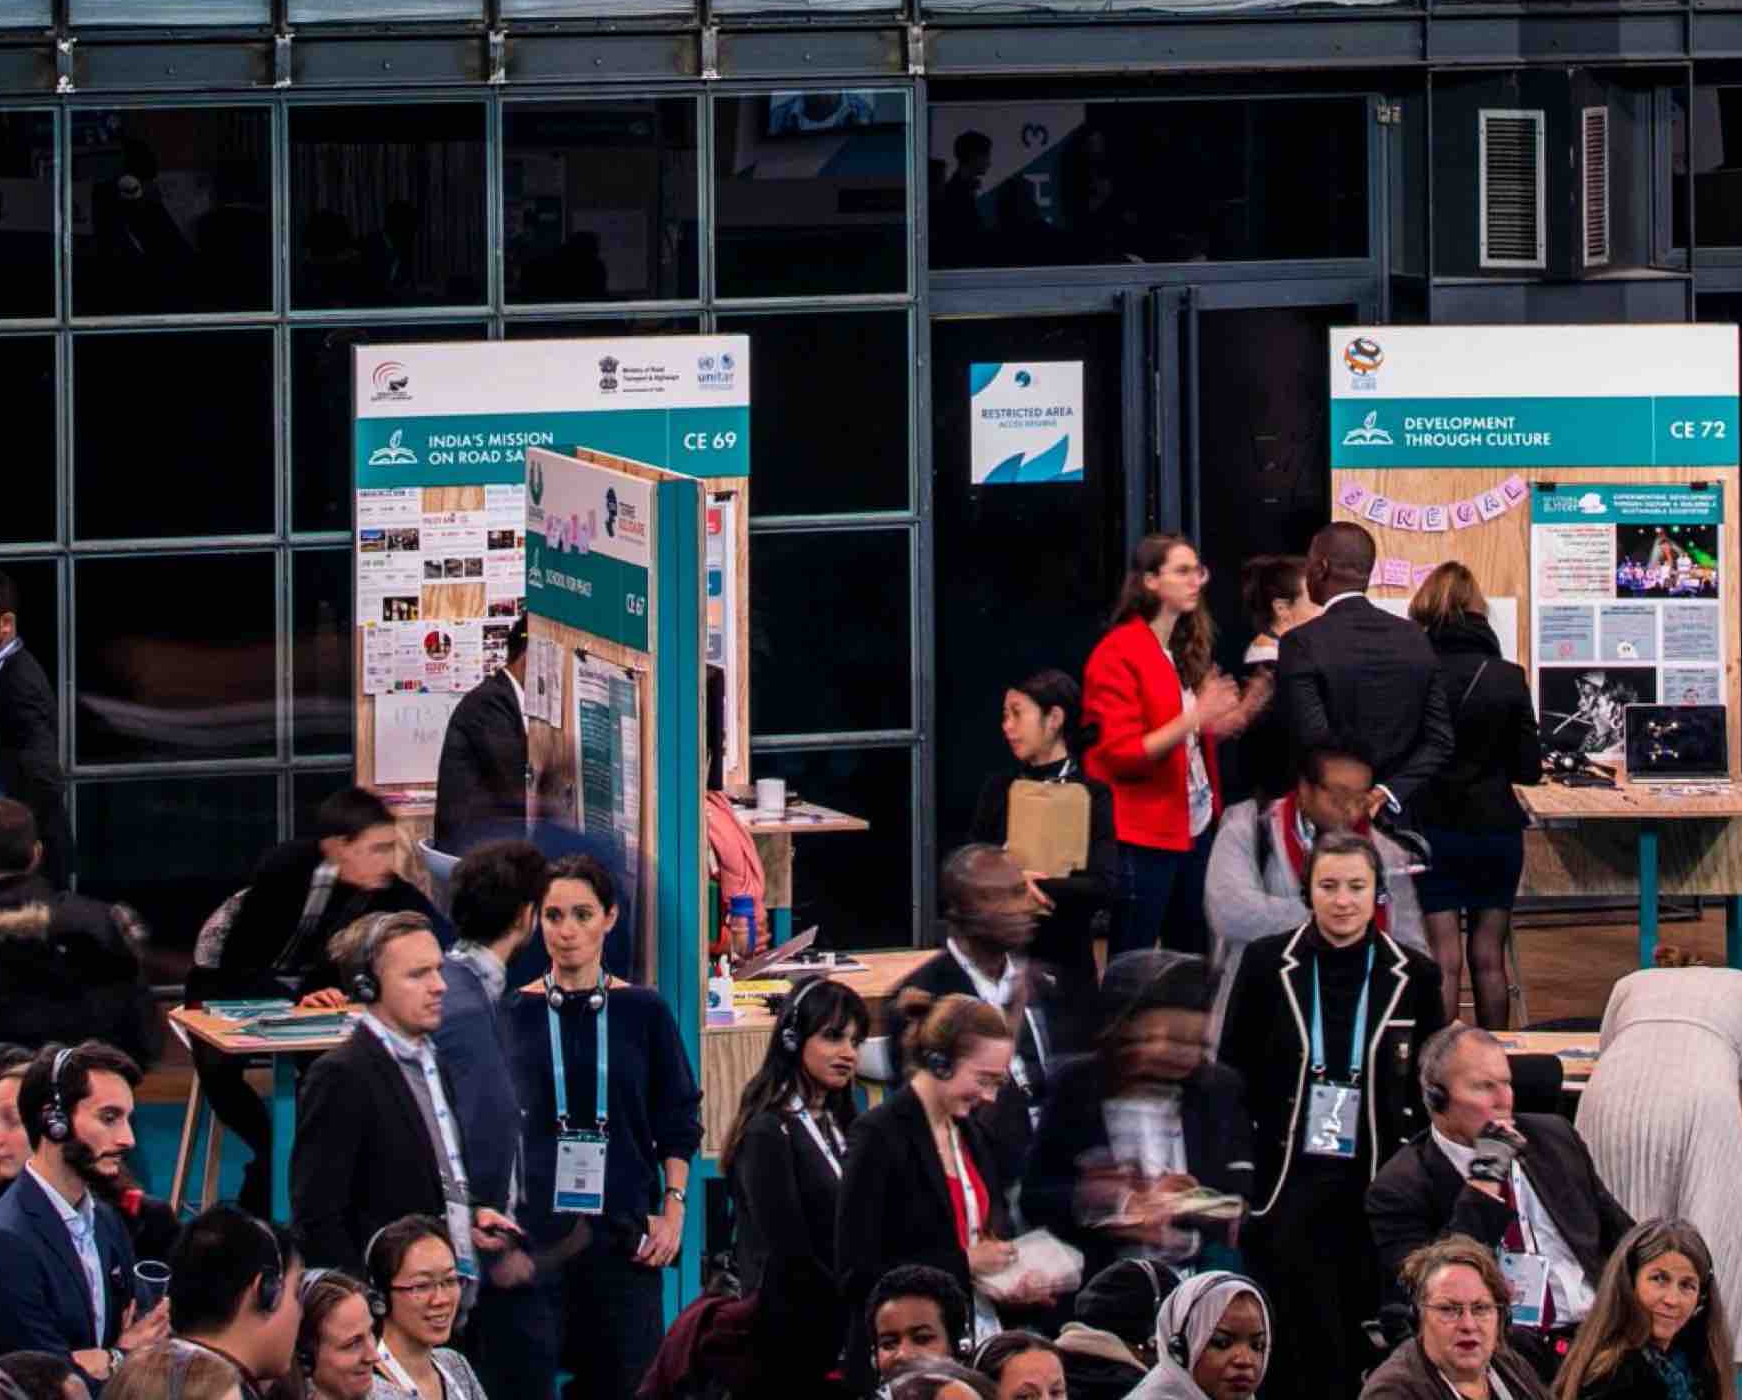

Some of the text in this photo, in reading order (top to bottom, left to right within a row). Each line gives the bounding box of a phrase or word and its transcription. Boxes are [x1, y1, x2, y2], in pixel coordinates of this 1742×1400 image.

[981, 407, 1073, 419] RESTRICTED AREA
[1405, 417, 1515, 430] DEVELOPMENT
[1670, 422, 1726, 439] CE 72
[429, 431, 554, 448] INDIA'S MISSION
[684, 432, 737, 449] CE 69
[1405, 431, 1551, 447] THROUGH CULTURE
[429, 449, 453, 465] ON
[459, 447, 500, 463] ROAD
